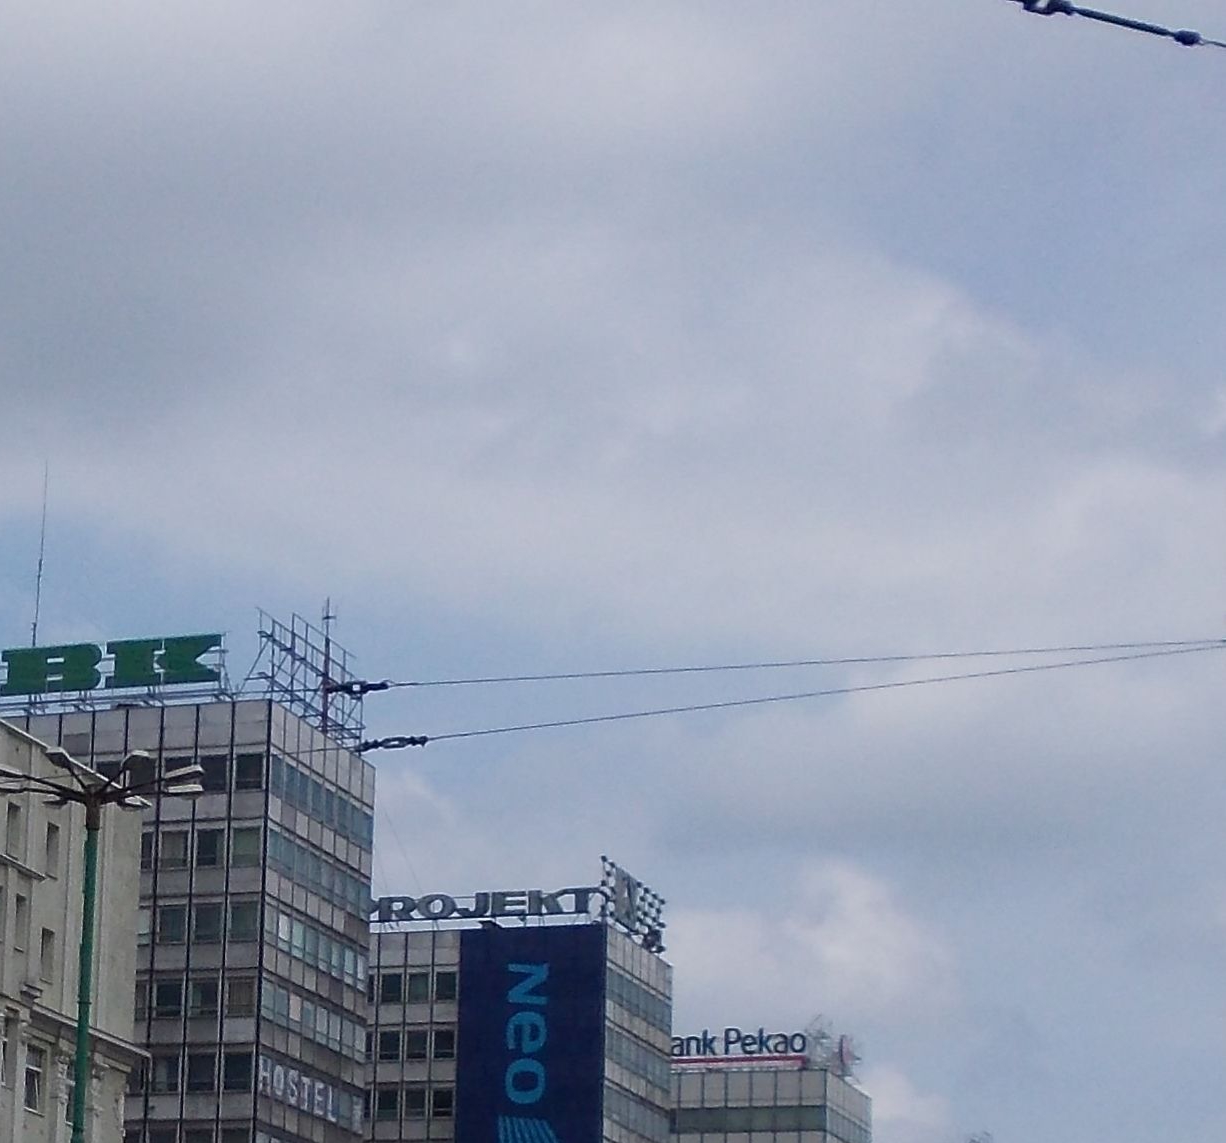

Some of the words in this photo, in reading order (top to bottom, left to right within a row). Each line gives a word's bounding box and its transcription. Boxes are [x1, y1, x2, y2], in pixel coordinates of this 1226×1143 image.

[371, 887, 606, 922] ROJEKT
[671, 1030, 717, 1057] ank
[724, 1027, 806, 1055] Pekao
[259, 1055, 338, 1123] HOSTEL
